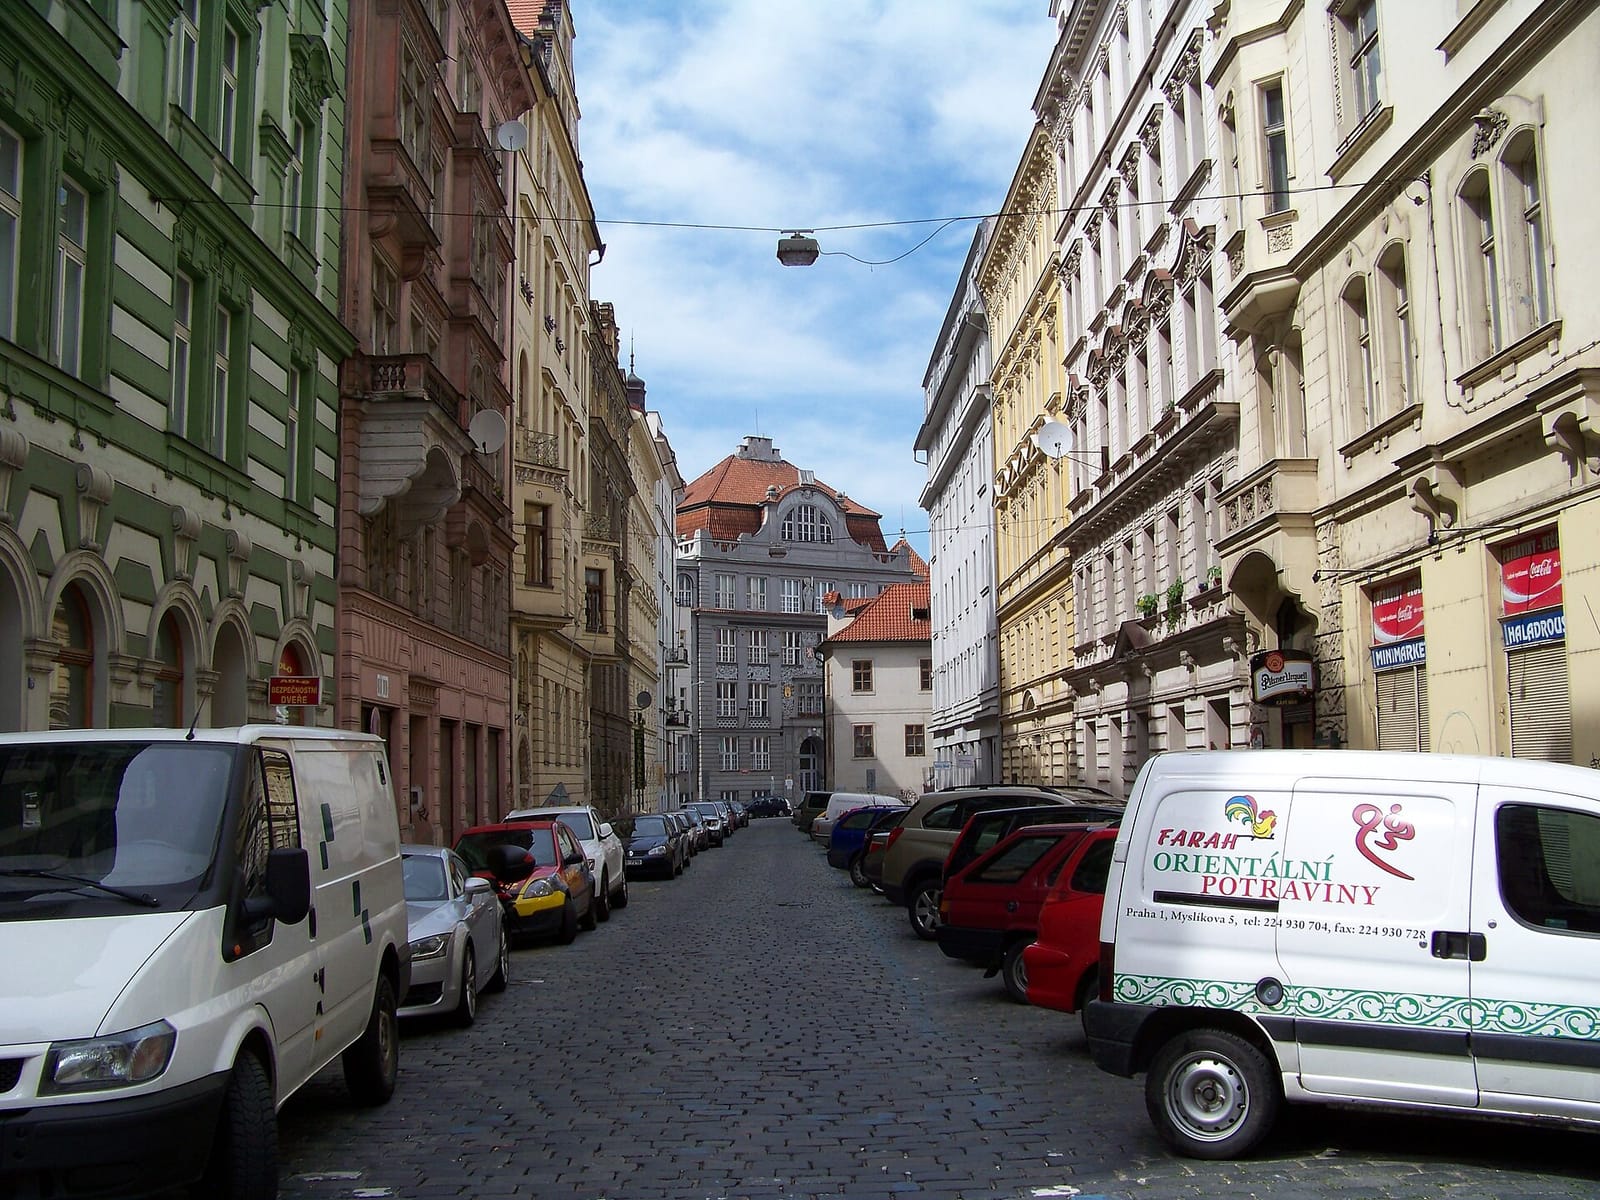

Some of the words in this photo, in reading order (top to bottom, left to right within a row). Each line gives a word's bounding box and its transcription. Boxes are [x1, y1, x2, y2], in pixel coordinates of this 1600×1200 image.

[1157, 828, 1238, 850] FARAH
[1153, 851, 1335, 882] ORIENTÁLNÍ
[1201, 875, 1381, 906] POTRAVINY
[1126, 907, 1156, 919] Praha
[1159, 910, 1168, 922] 1,
[1228, 914, 1238, 926] 5,
[1243, 916, 1261, 926] tel:
[1264, 918, 1283, 928] 224
[1286, 919, 1305, 930] 930
[1308, 921, 1331, 934] 704,
[1334, 922, 1356, 934] fax:
[1359, 925, 1379, 935] 224
[1382, 927, 1402, 938] 930
[1406, 929, 1426, 939] 728
